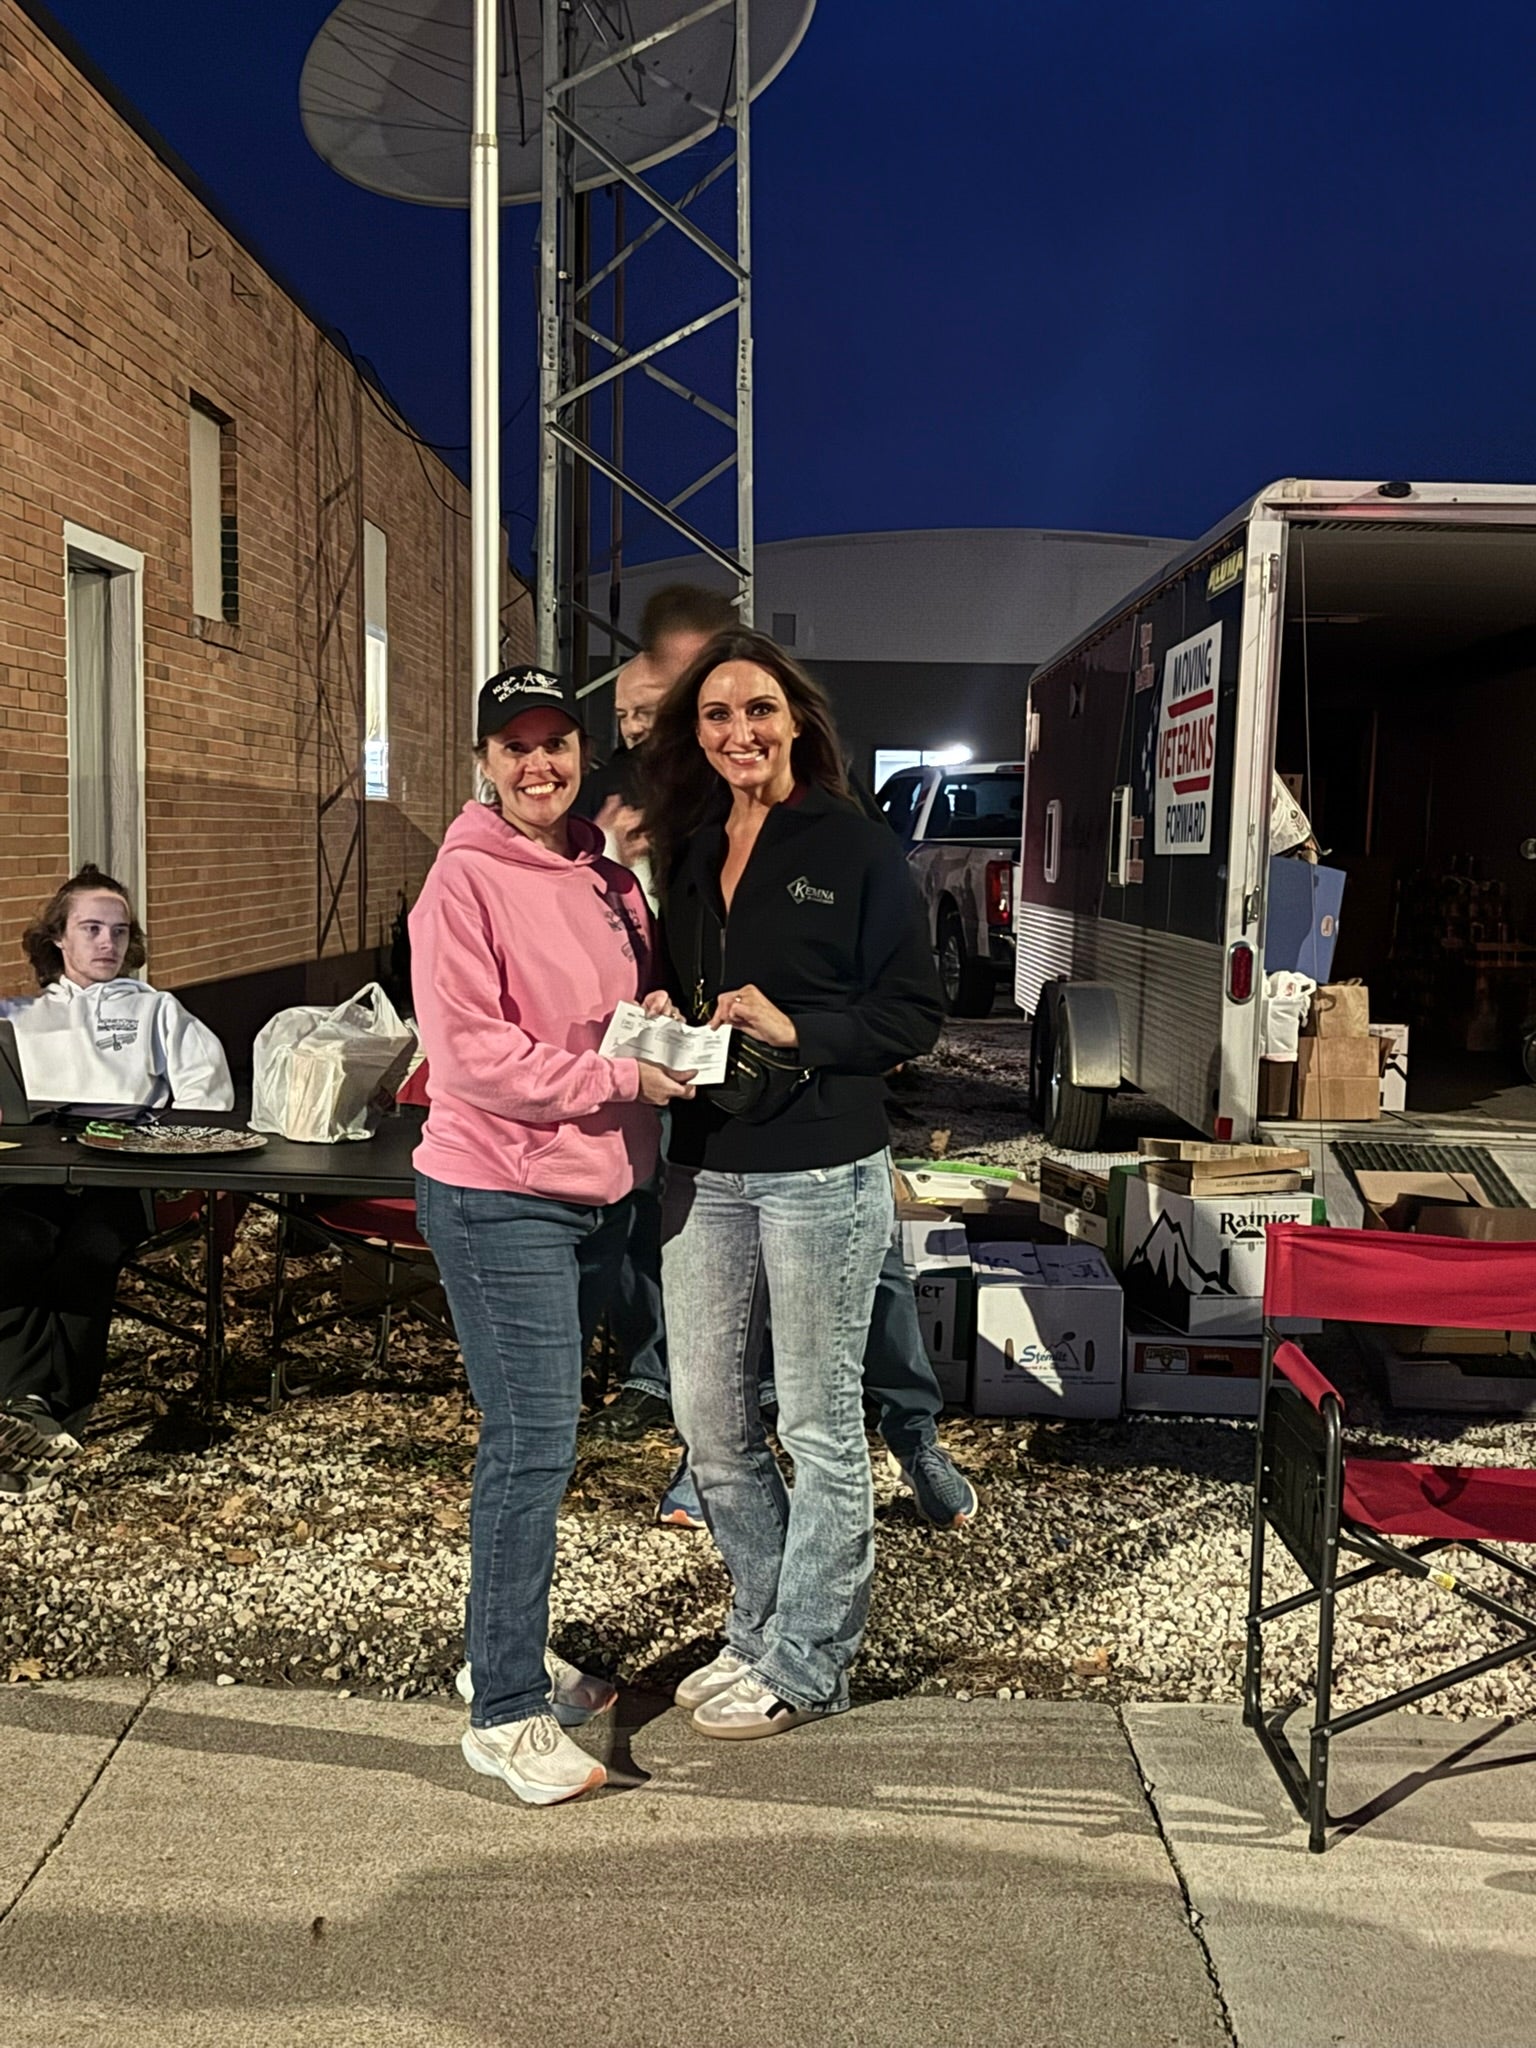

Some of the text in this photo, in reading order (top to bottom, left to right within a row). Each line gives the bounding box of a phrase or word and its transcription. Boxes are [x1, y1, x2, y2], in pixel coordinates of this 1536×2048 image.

[1172, 638, 1213, 699] MOVING
[1158, 714, 1215, 780] VETERANS
[1165, 801, 1207, 845] FORWARD
